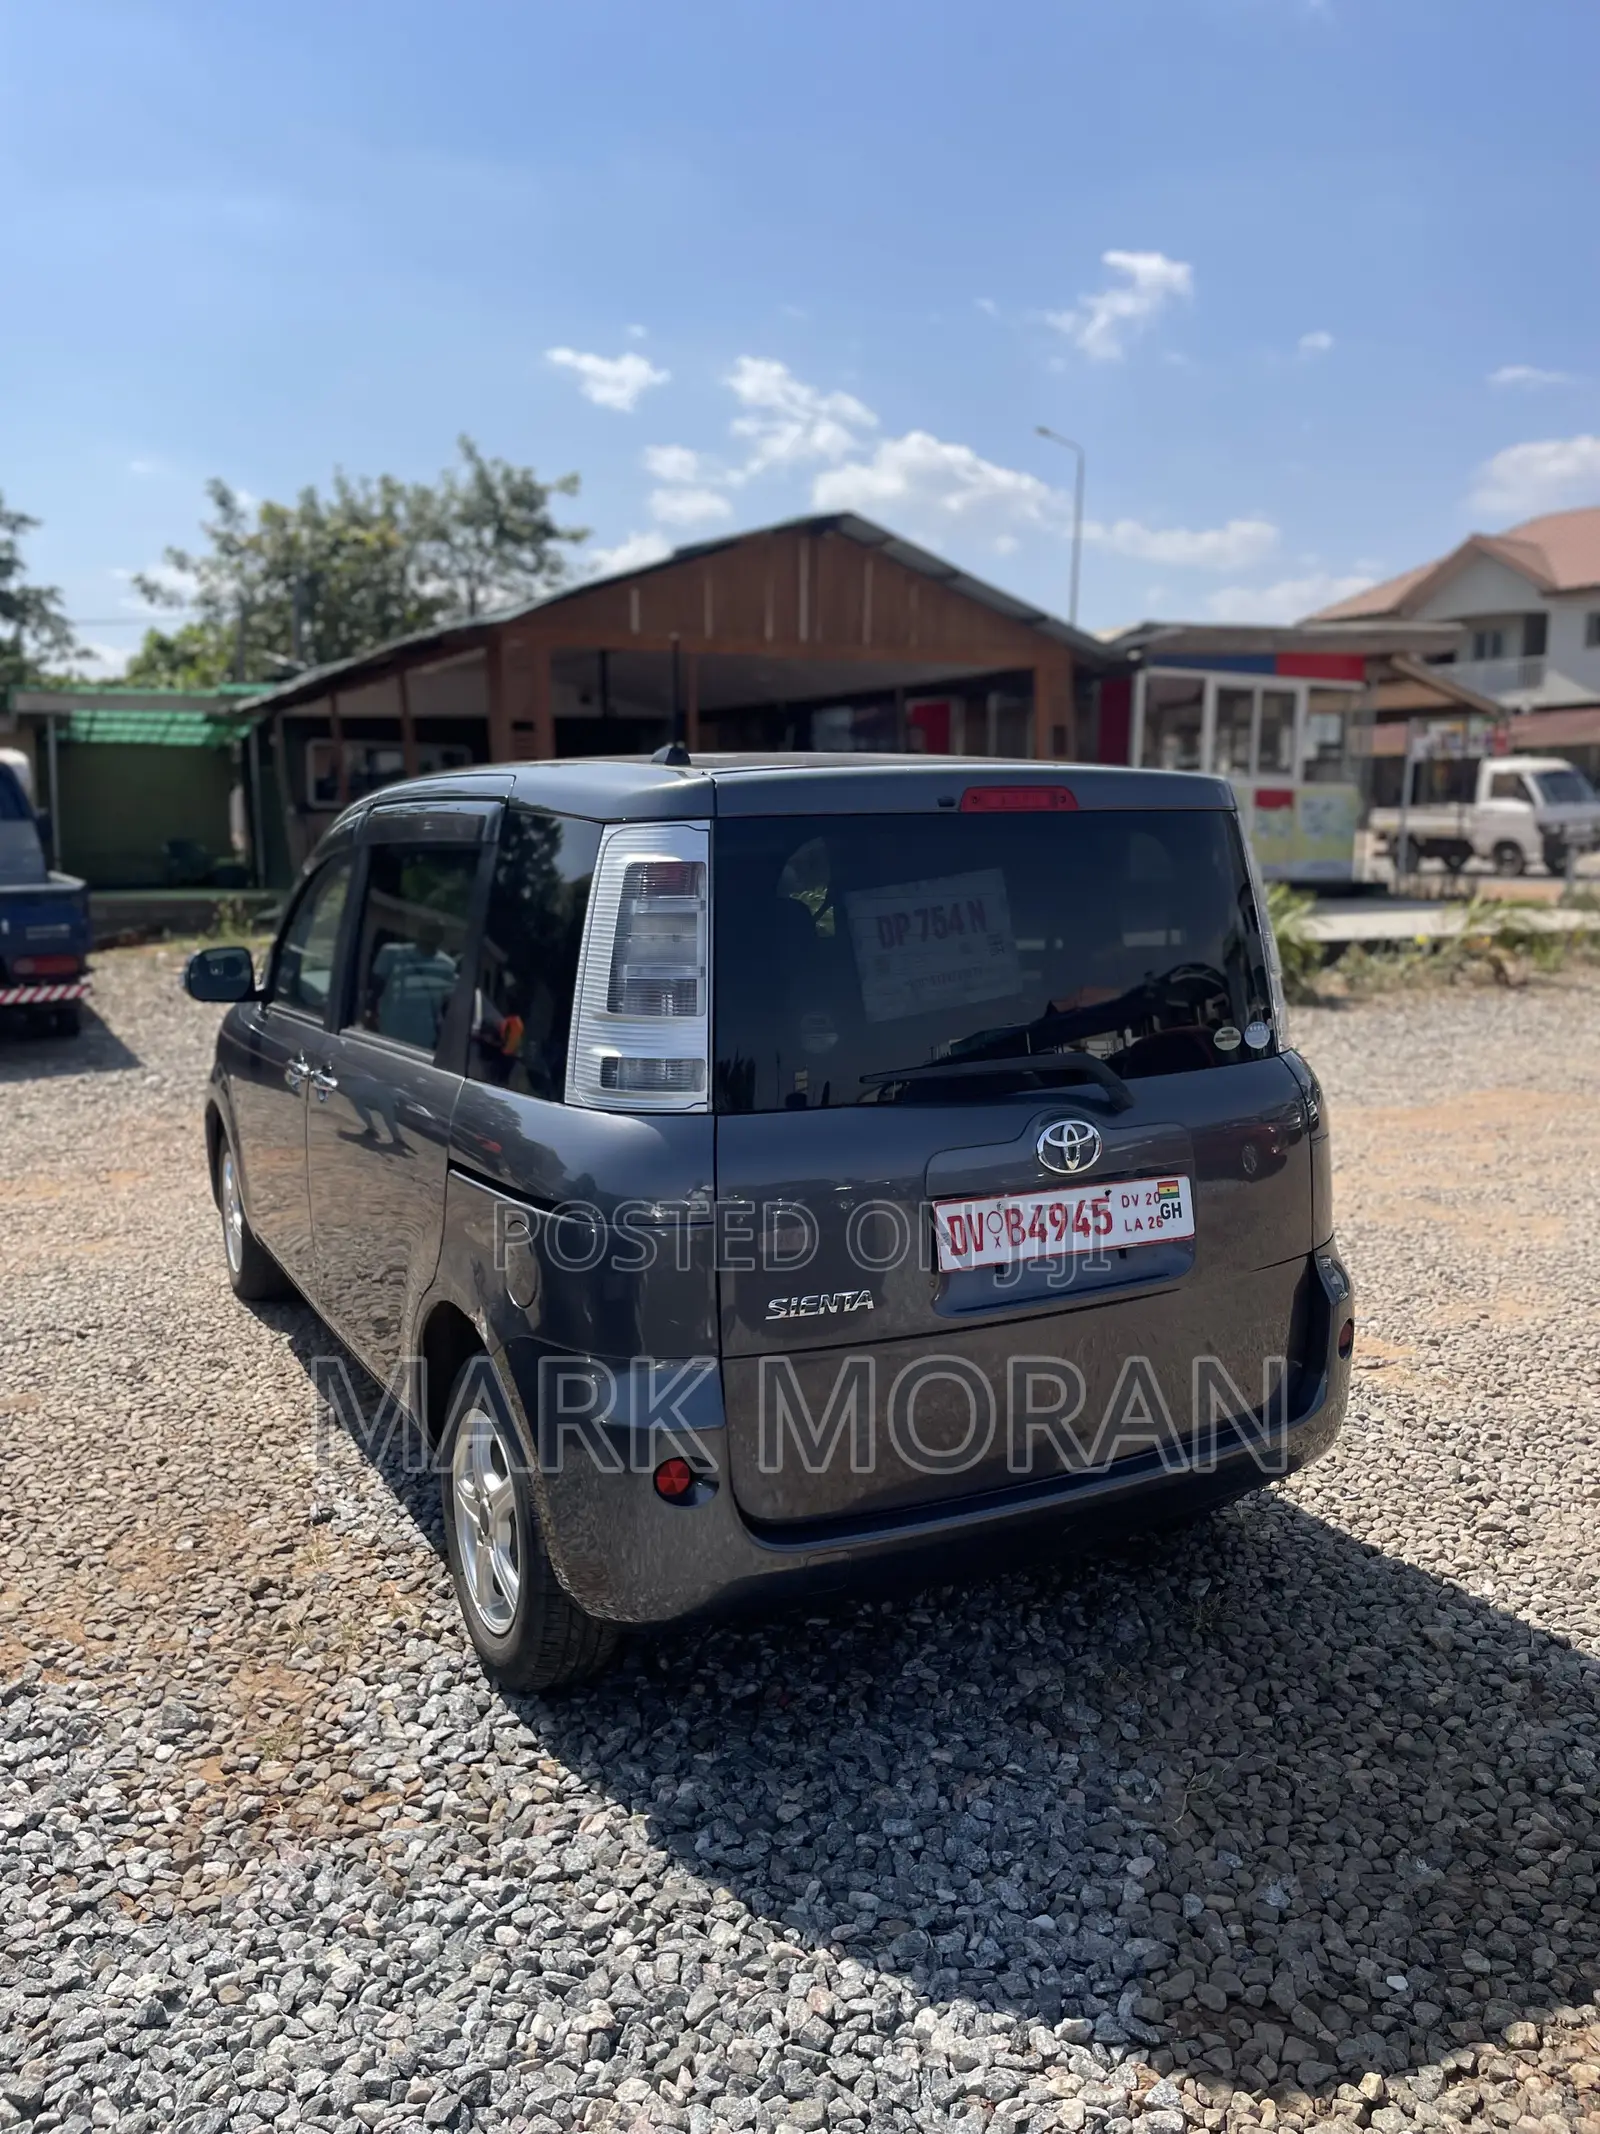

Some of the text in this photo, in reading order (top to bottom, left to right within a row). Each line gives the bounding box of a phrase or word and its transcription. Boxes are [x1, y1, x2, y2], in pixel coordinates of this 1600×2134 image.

[914, 903, 965, 942] 754
[1121, 1191, 1161, 1208] DV 20
[1160, 1202, 1183, 1219] GH
[946, 1197, 1113, 1255] DV B4945
[1125, 1214, 1164, 1233] LA 26
[765, 1290, 874, 1321] SIENTA
